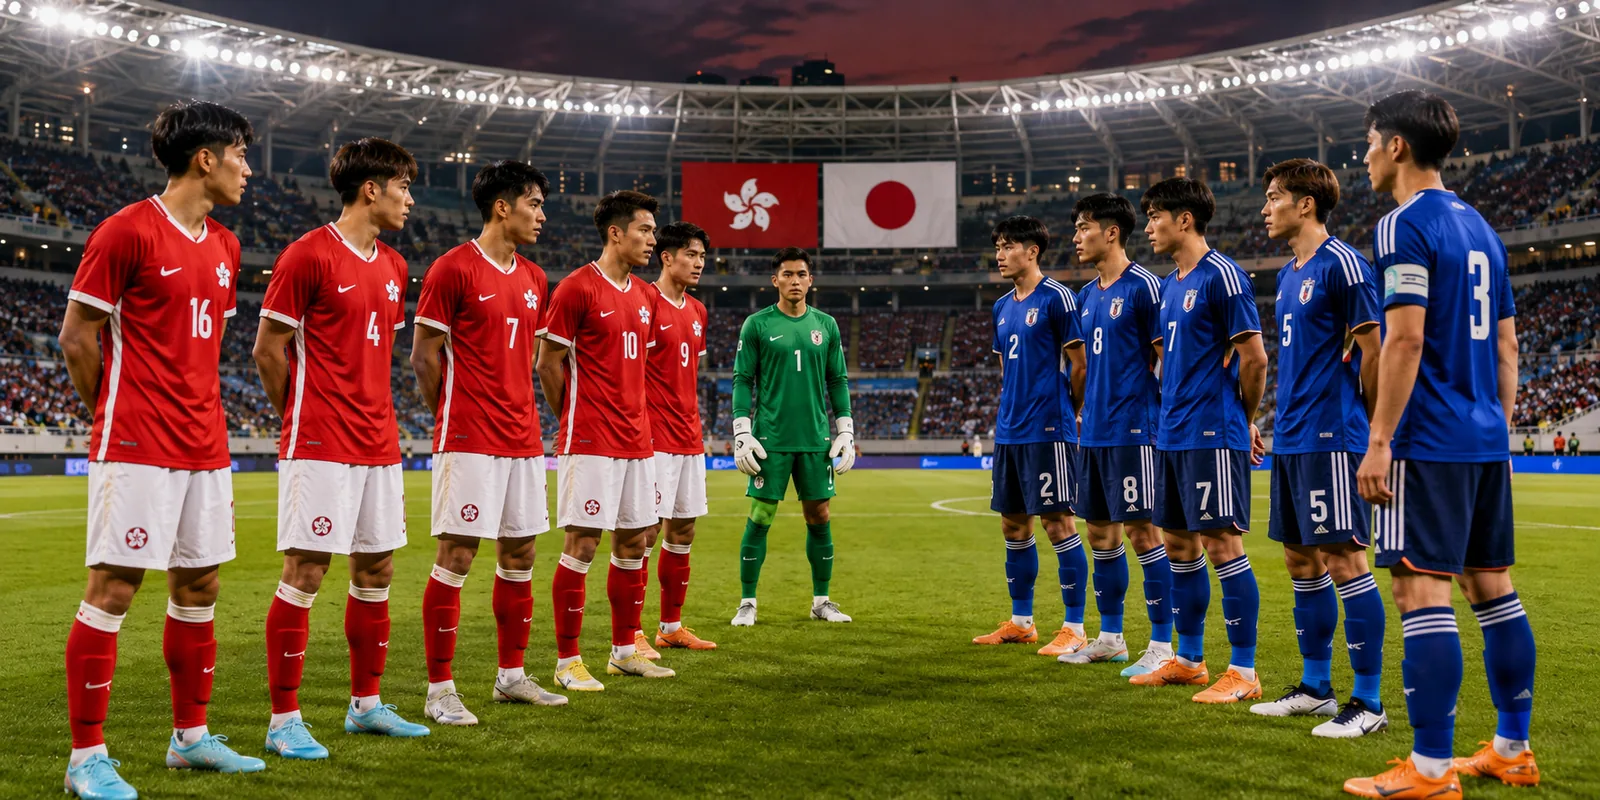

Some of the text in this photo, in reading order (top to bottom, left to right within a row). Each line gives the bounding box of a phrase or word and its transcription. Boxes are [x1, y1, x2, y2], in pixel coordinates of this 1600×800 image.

[1467, 249, 1491, 341] 3
[190, 297, 212, 339] 16
[366, 312, 380, 347] 4
[506, 317, 519, 349] 7
[1281, 313, 1292, 347] 5
[622, 331, 638, 360] 10
[1008, 334, 1019, 359] 2
[1092, 326, 1103, 355] 8
[1168, 321, 1177, 352] 7
[681, 342, 690, 367] 9
[794, 349, 802, 372] 1
[1039, 473, 1053, 498] 2
[1123, 476, 1138, 503] 8
[1196, 481, 1211, 511] 7
[1310, 490, 1327, 522] 5
